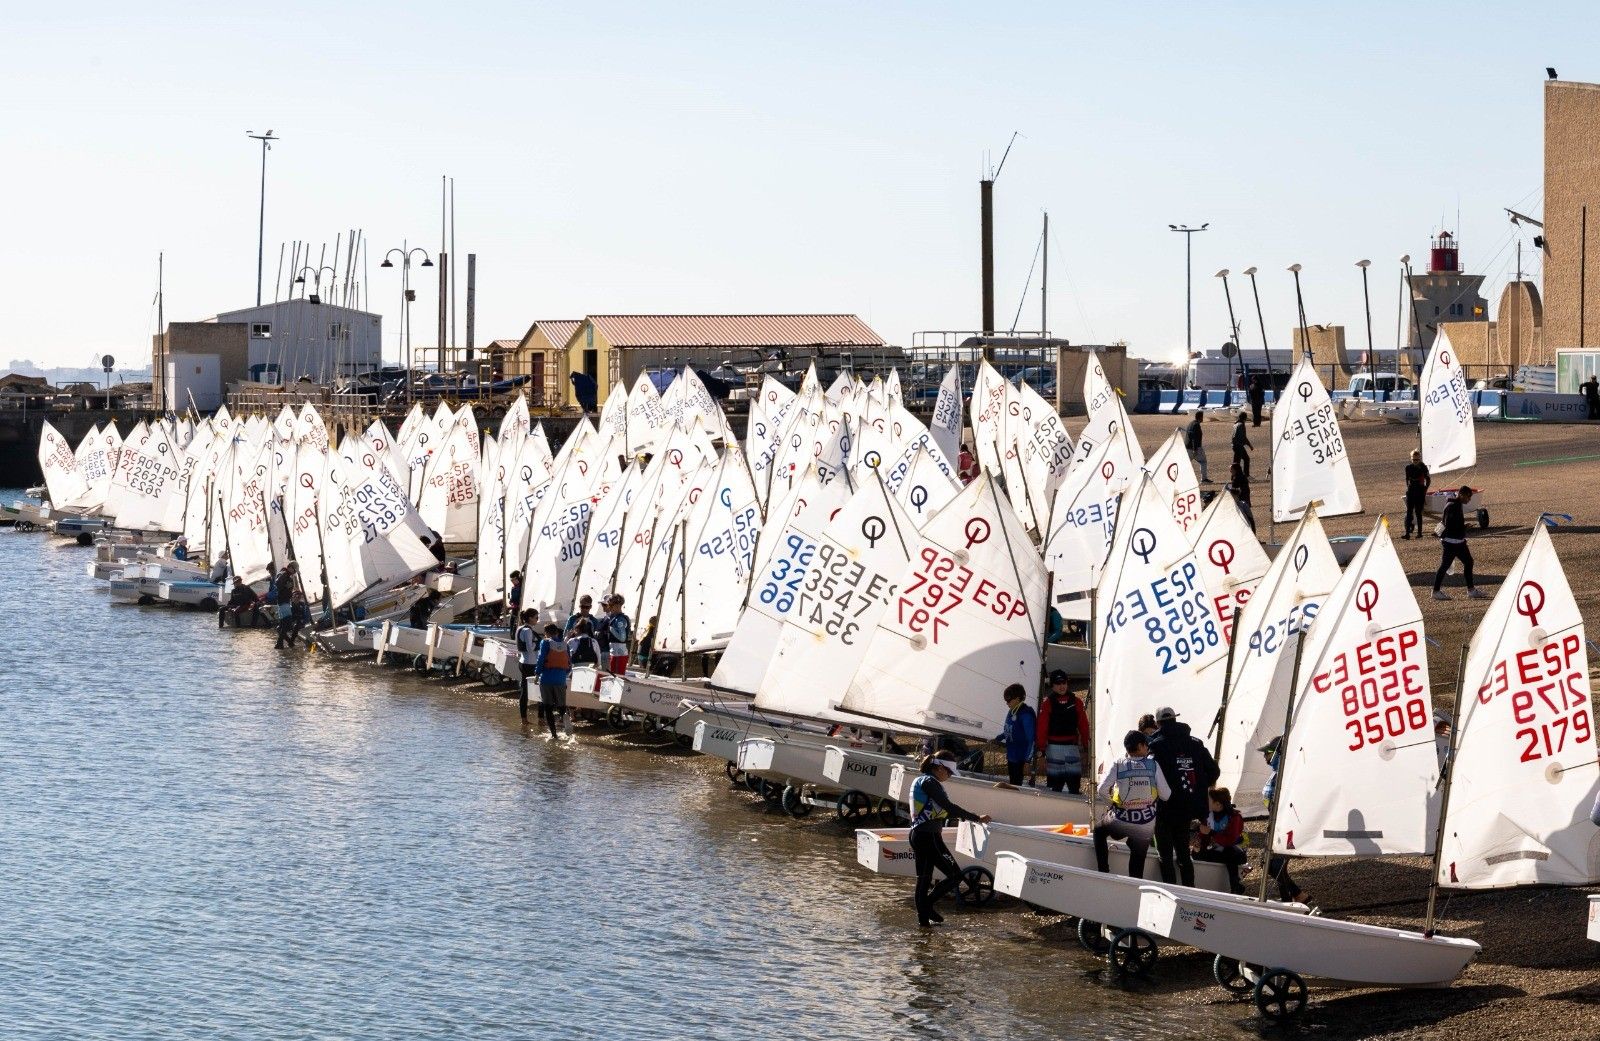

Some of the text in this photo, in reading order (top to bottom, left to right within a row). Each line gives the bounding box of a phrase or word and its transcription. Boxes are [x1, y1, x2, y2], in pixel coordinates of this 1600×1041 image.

[1033, 416, 1057, 445] ESP
[1306, 404, 1331, 430] ESP
[1046, 442, 1075, 475] 3401
[1312, 437, 1343, 465] 3413
[133, 467, 165, 487] 2623
[363, 510, 397, 544] 2739
[805, 568, 872, 618] 3547
[903, 571, 963, 616] 797
[972, 579, 1027, 622] ESP
[1151, 561, 1197, 608] ESP
[1155, 619, 1219, 675] 2958
[1355, 630, 1418, 676] ESP
[1516, 634, 1580, 684] ESP
[1345, 698, 1427, 752] 3508
[1515, 709, 1591, 763] 2179
